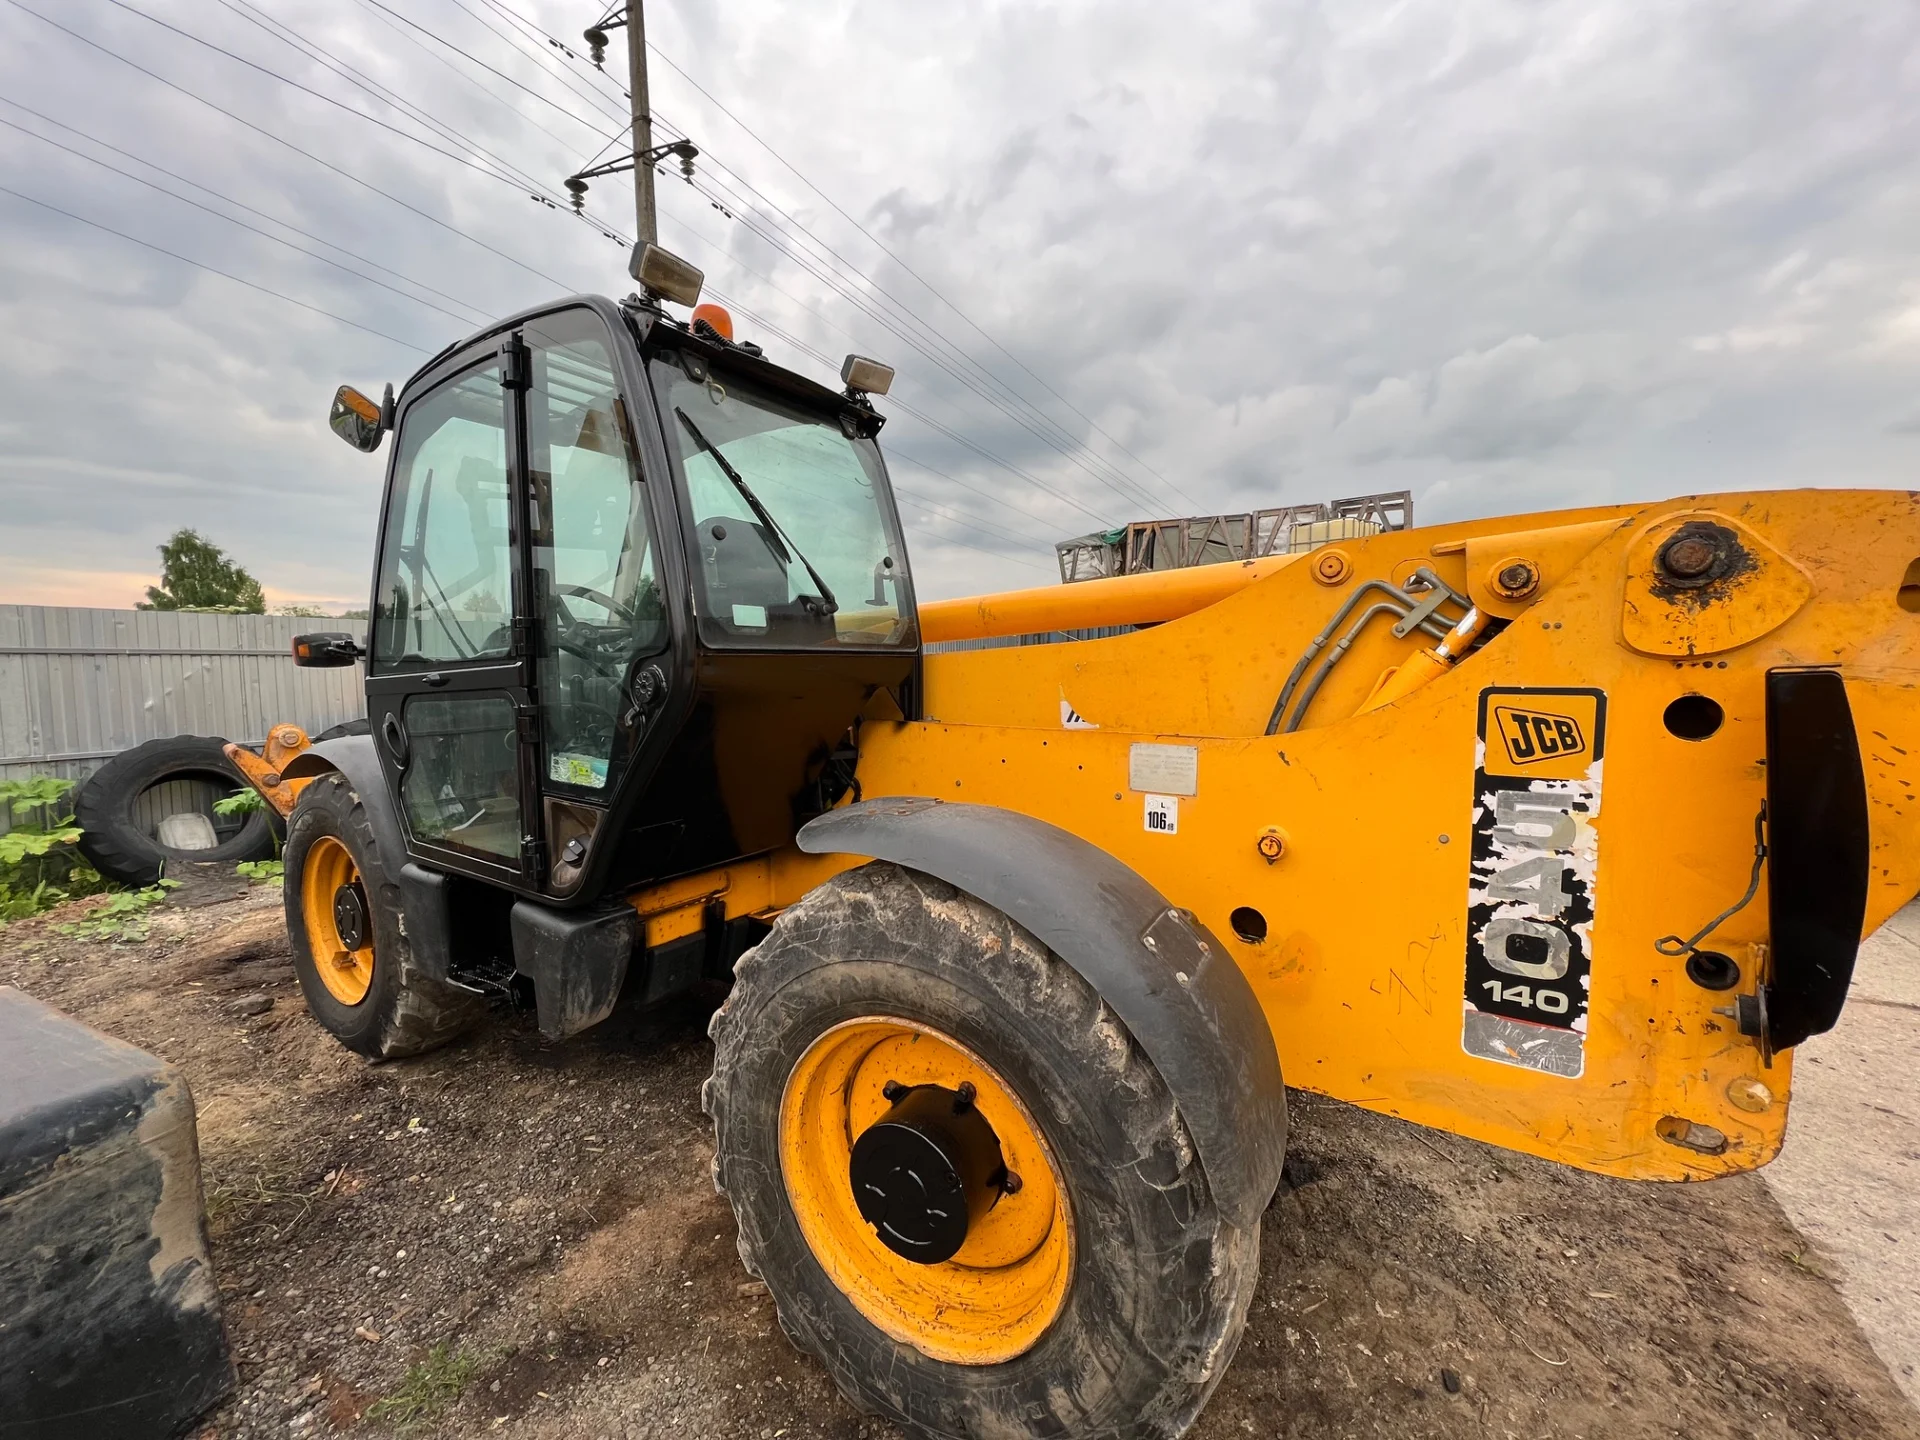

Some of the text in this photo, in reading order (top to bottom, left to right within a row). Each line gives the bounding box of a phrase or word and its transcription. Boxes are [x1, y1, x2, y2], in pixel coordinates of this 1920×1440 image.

[1510, 712, 1581, 759] JCB
[1147, 810, 1167, 830] 106
[1482, 980, 1569, 1014] 140
